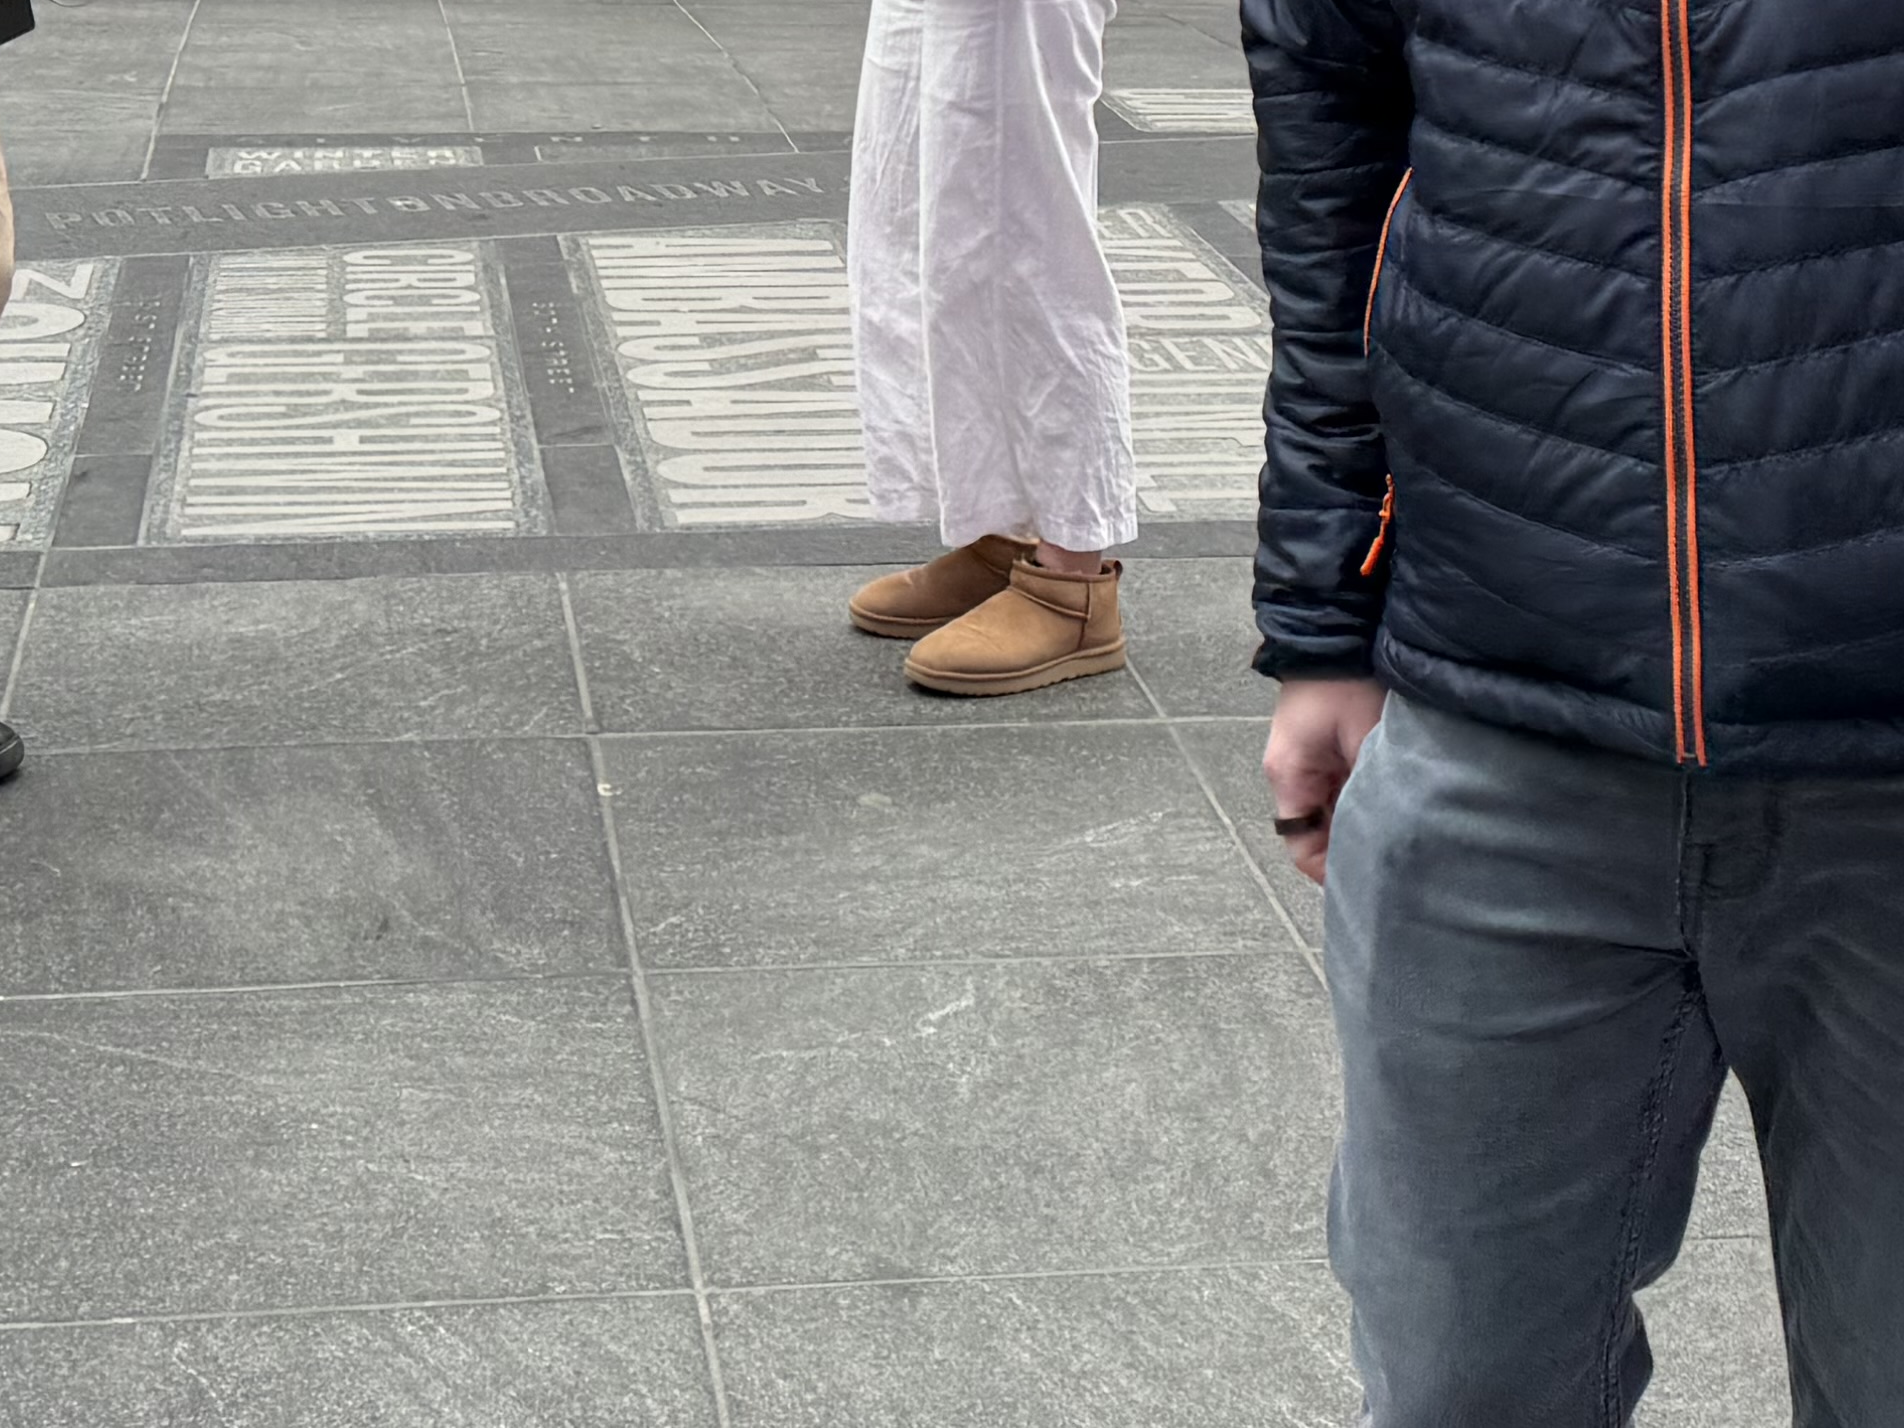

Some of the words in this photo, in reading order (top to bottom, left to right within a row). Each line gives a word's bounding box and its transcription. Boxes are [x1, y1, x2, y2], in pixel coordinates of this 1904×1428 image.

[46, 193, 392, 232] POTLIGHT
[484, 176, 828, 211] BROADWAY
[342, 248, 494, 338] CIRCLE
[181, 343, 516, 536] GERSHWIN
